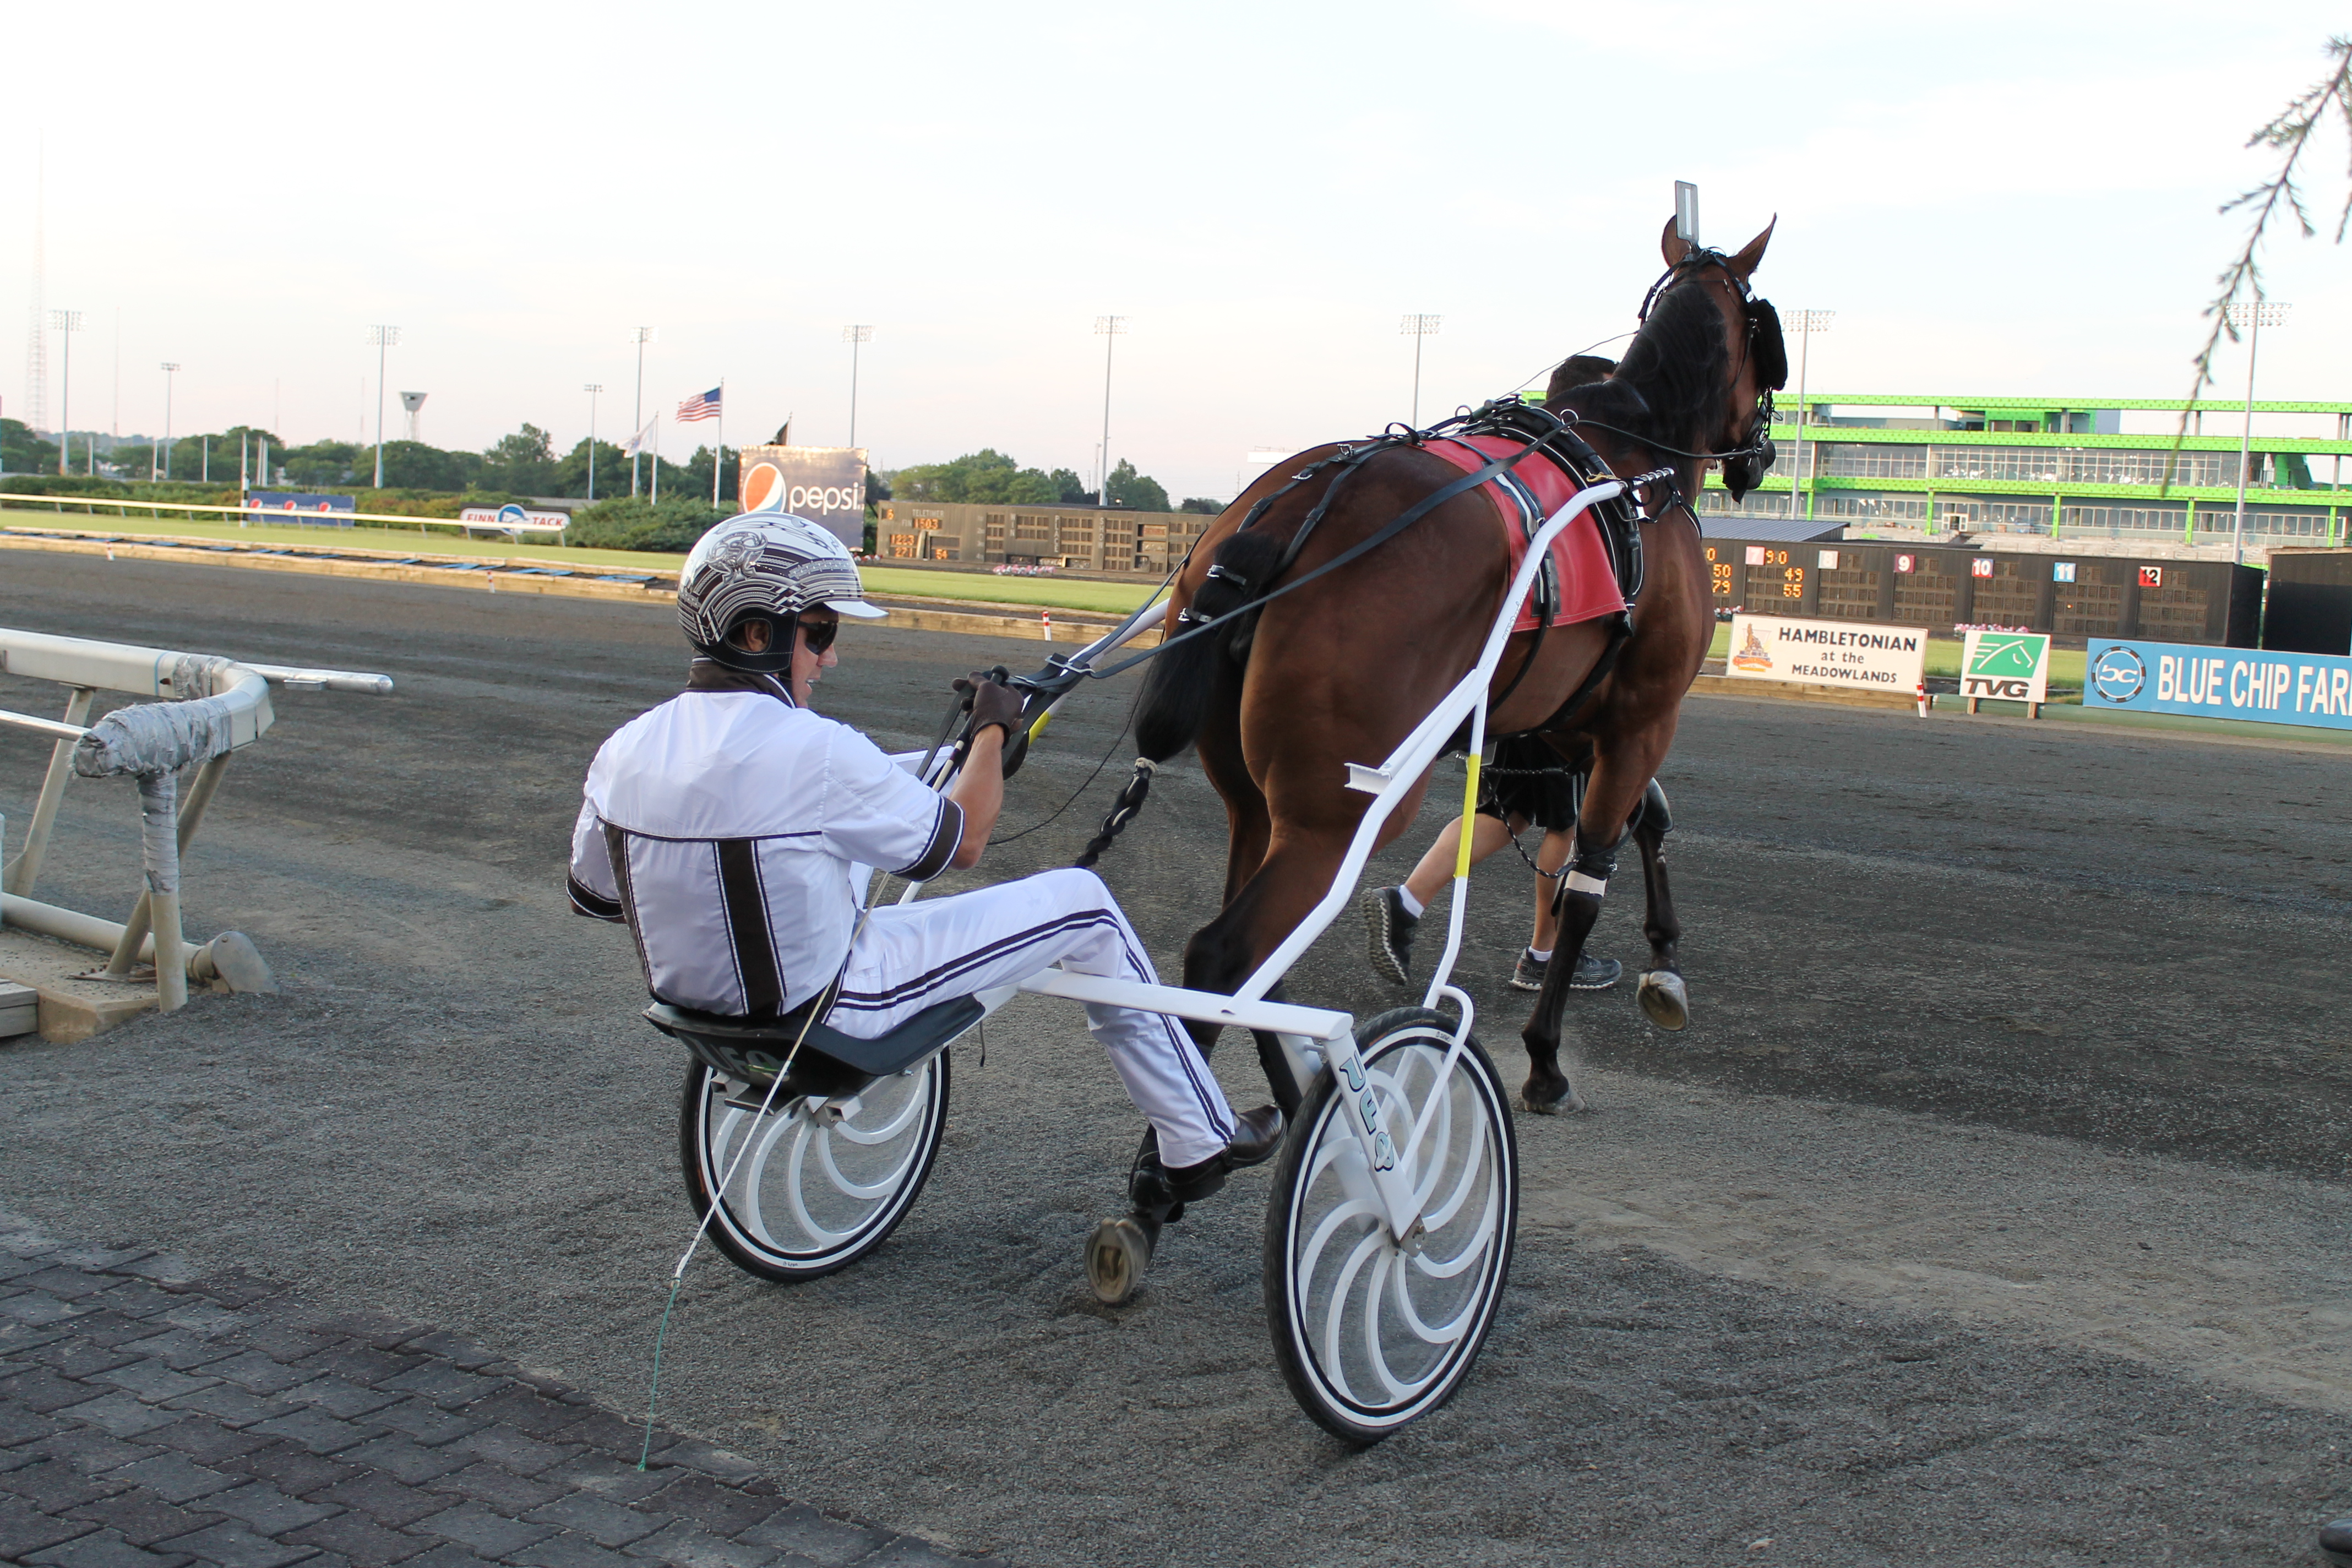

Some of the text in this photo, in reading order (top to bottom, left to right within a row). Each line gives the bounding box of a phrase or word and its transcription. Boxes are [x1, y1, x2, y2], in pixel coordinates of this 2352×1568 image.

[789, 482, 859, 515] pepsi
[468, 513, 564, 526] FINN TACK
[912, 509, 944, 518] TELETIMER
[1751, 549, 1760, 563] 7
[1823, 552, 1833, 567] 8
[1713, 563, 1732, 578] 50
[1898, 557, 1910, 571] 9
[1973, 560, 1991, 575] 10
[1784, 567, 1804, 582] 49
[2056, 564, 2074, 580] 11
[2143, 568, 2158, 584] 12
[1712, 579, 1732, 594] 79
[1783, 583, 1803, 598] 55
[1778, 627, 1917, 651] HAMBLETONIAN
[1821, 651, 1864, 664] at the
[1792, 664, 1897, 683] MEADOWLANDS
[1965, 678, 2030, 698] TVG
[2157, 655, 2352, 716] BLUE CHIP FAR
